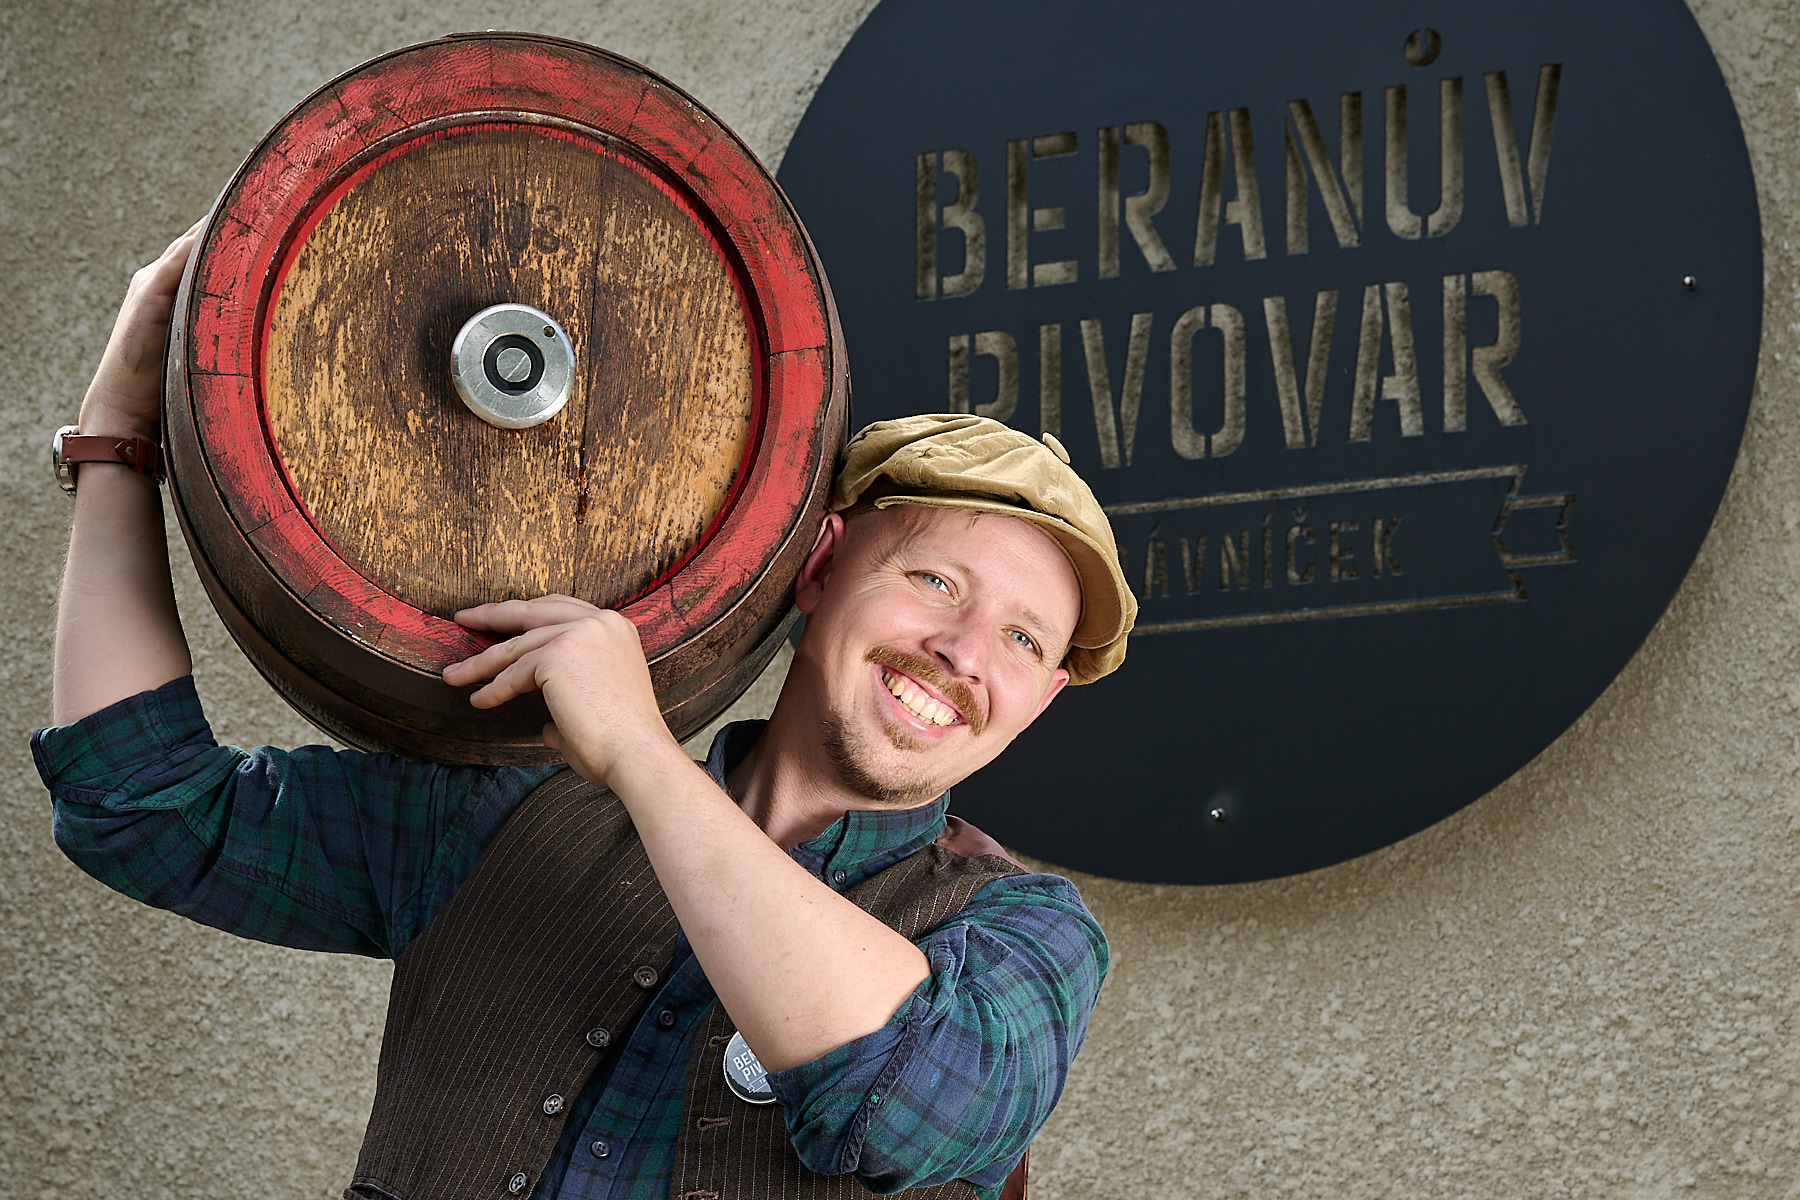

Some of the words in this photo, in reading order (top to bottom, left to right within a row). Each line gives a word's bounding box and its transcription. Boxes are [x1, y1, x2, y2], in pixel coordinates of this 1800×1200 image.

[914, 27, 1563, 301] BERANŮV
[948, 269, 1527, 469] PIVOVAR
[1118, 508, 1405, 600] ÁVNÍČEK
